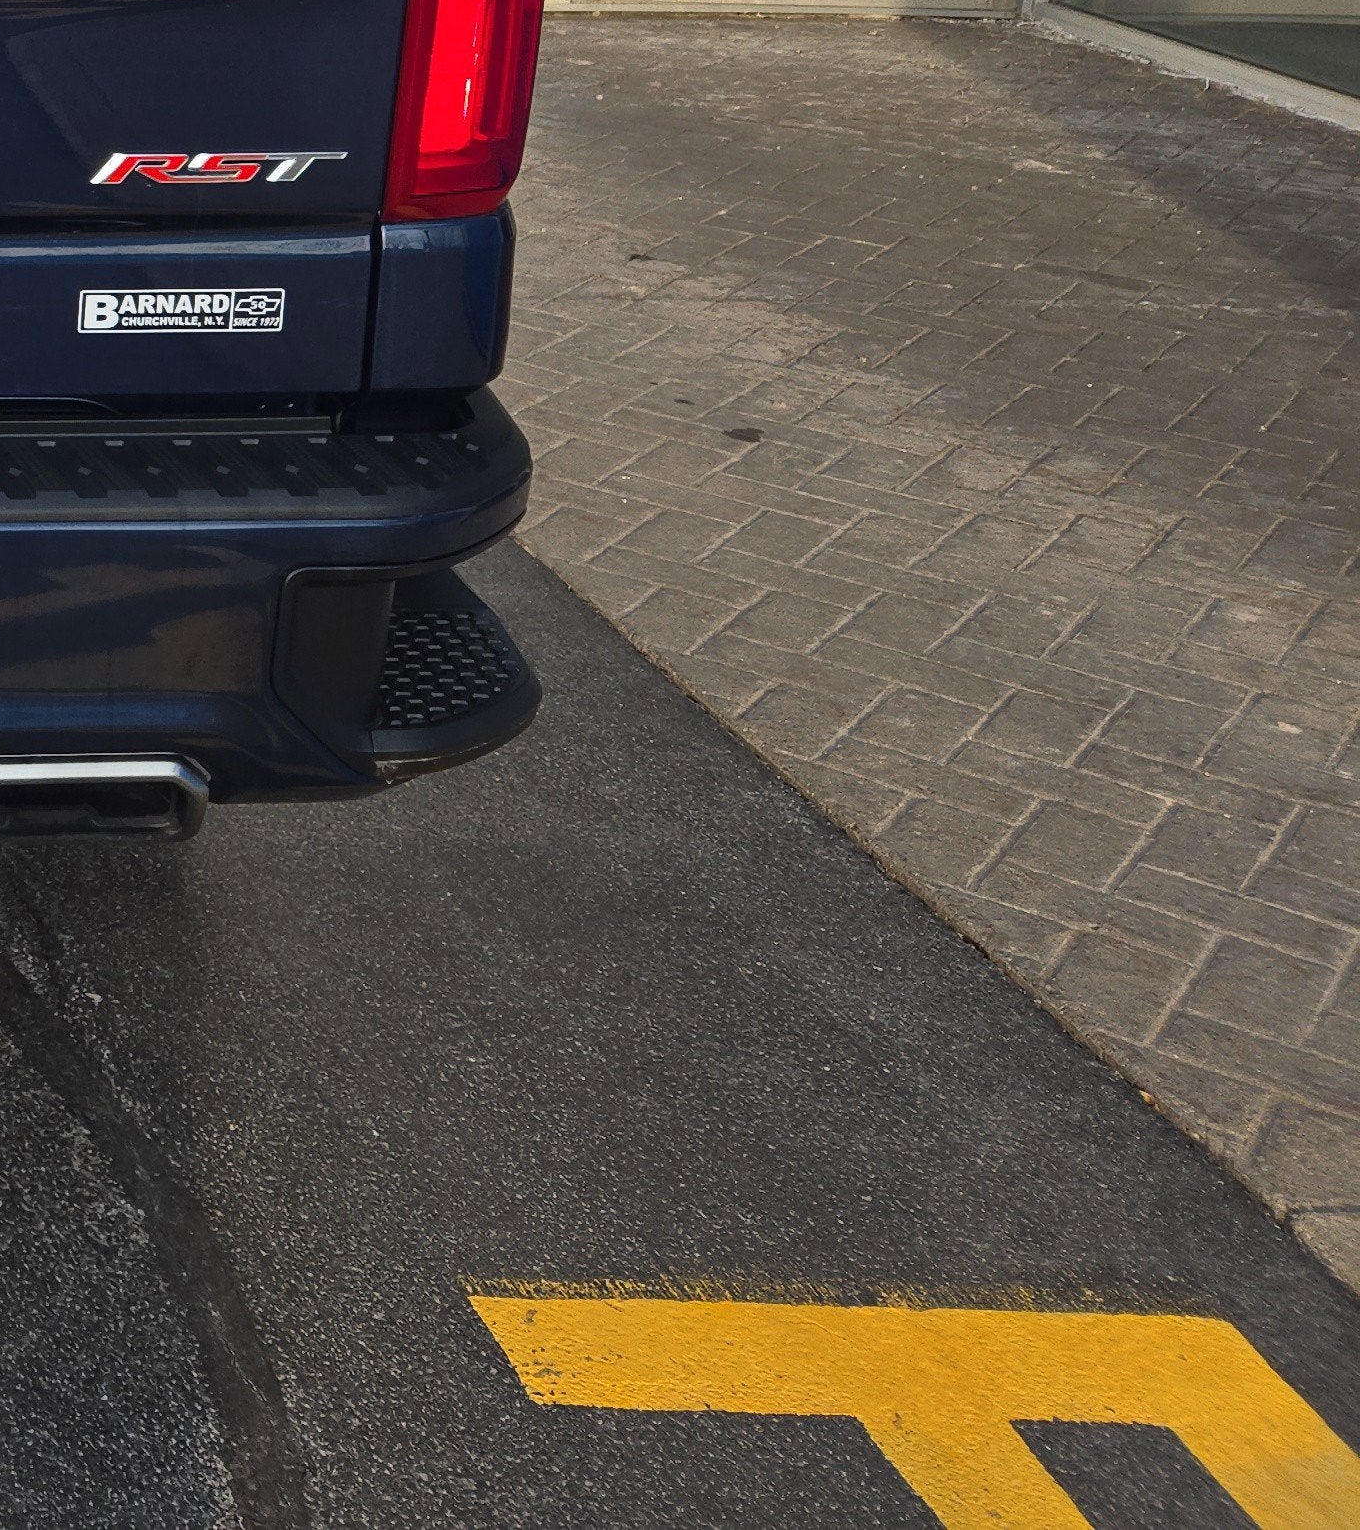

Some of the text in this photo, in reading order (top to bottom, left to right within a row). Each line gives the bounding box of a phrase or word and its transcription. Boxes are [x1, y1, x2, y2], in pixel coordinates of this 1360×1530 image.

[89, 151, 349, 185] RST
[83, 293, 231, 329] BARNARD
[121, 315, 225, 328] CHURCHVILLE, N.Y.
[232, 316, 281, 328] SINCE 1972
